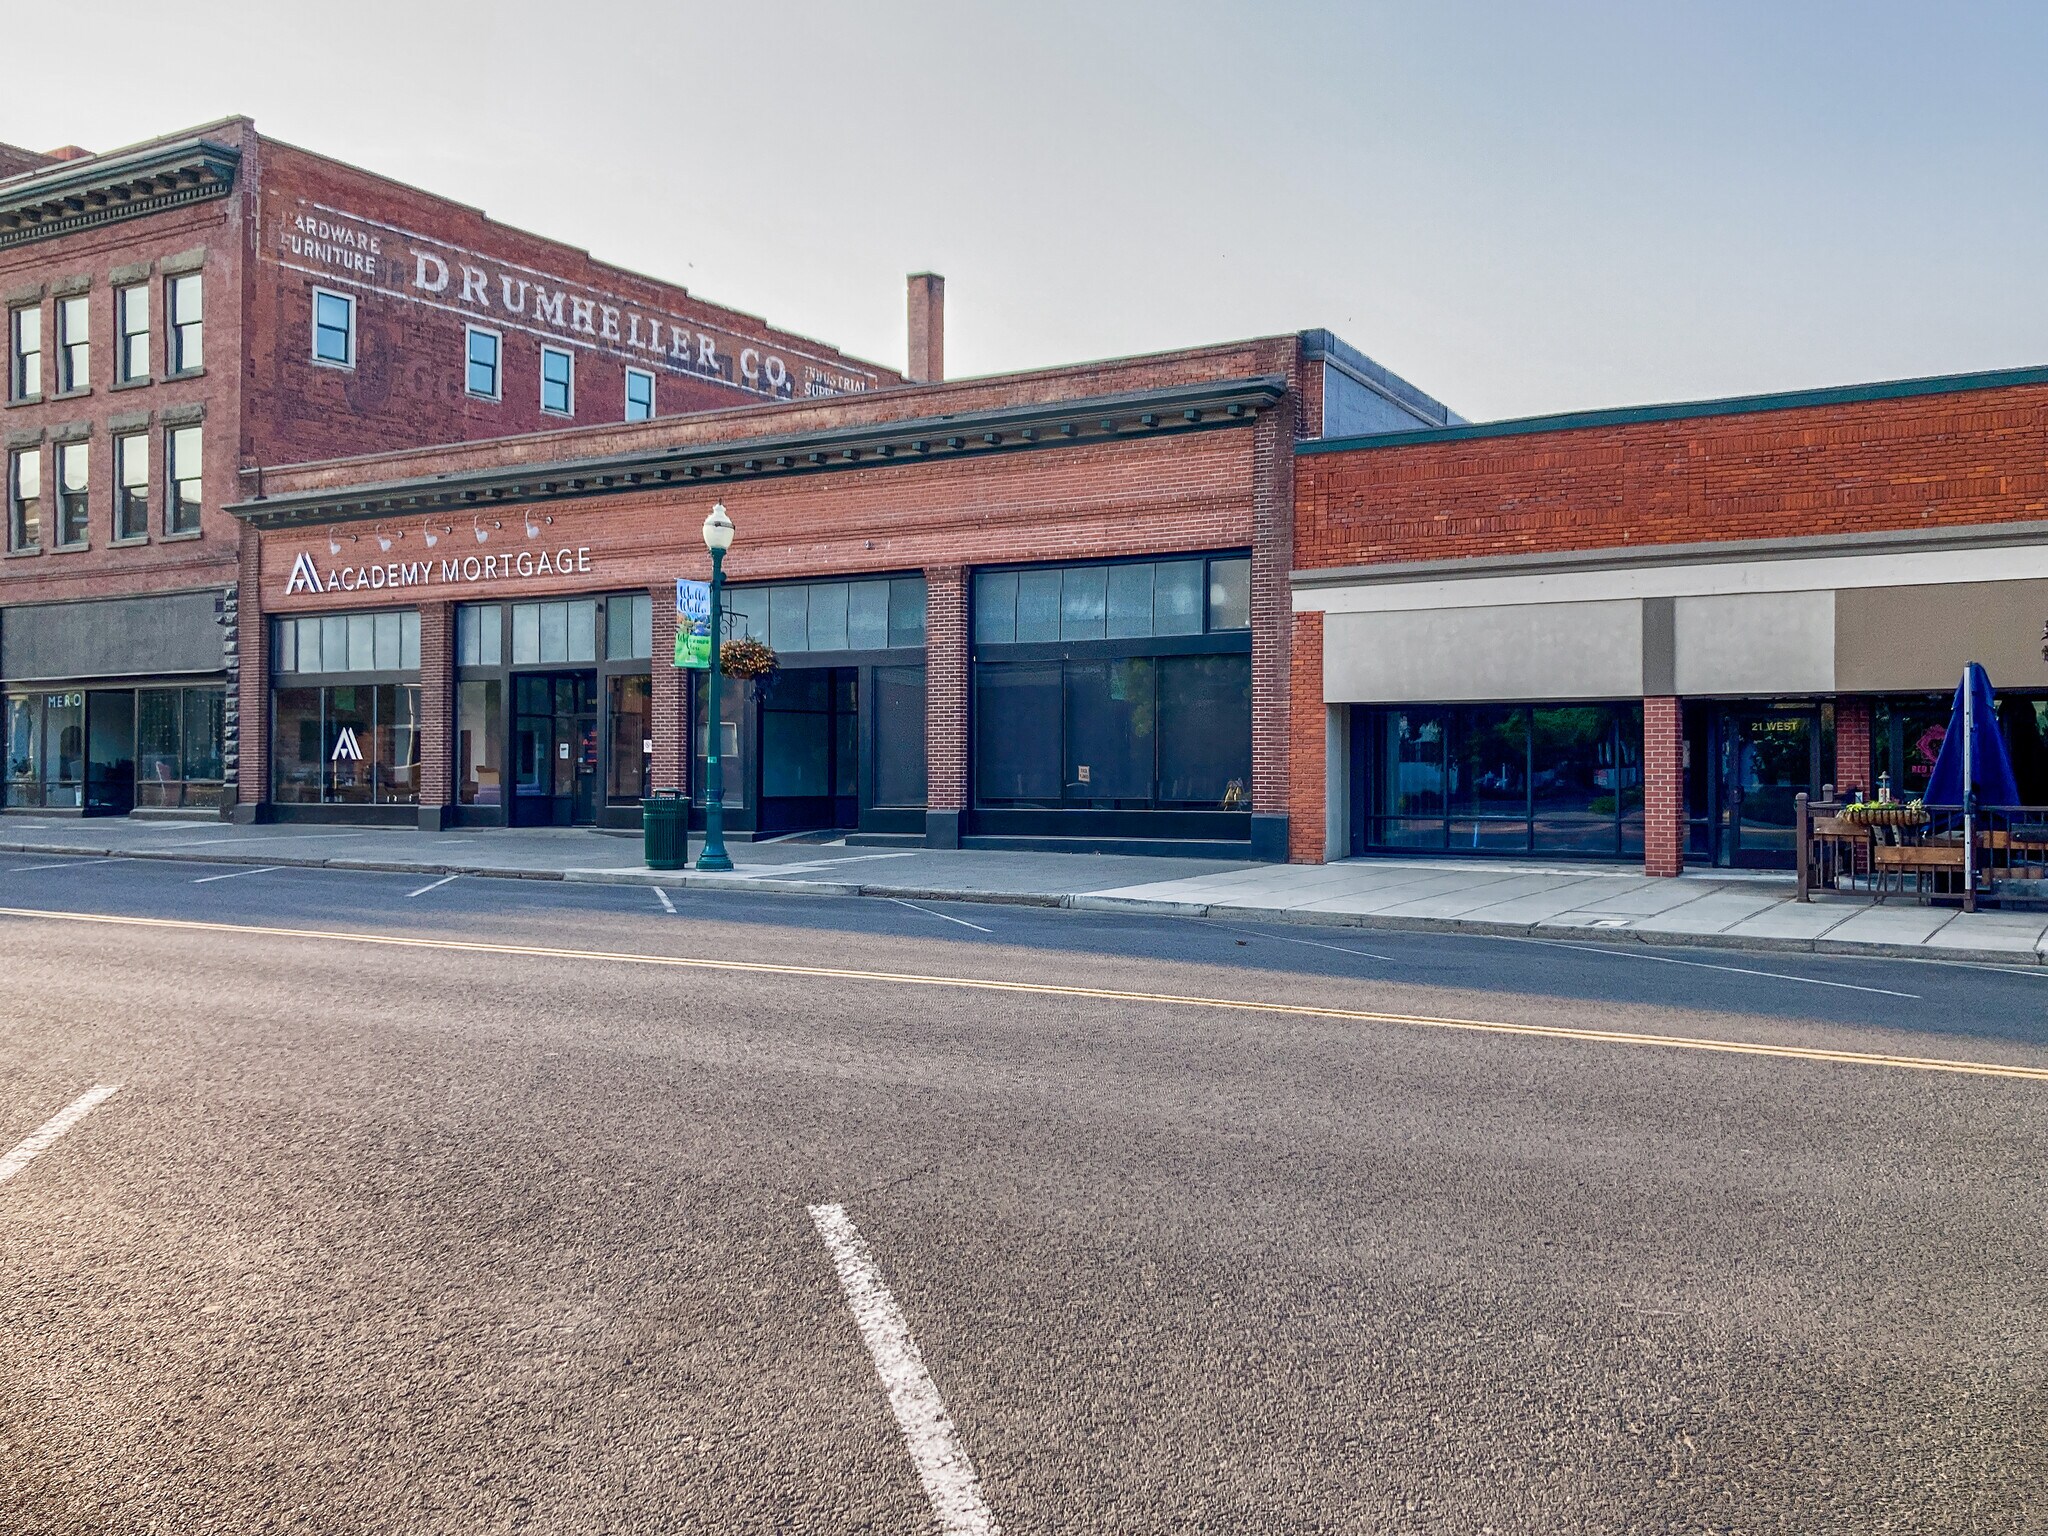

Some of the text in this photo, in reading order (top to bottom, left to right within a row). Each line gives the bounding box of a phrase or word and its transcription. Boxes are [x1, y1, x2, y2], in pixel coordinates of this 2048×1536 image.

[410, 248, 721, 371] DRUMHELLER
[327, 560, 434, 591] ACADEMY
[442, 547, 592, 583] MORTGAGE
[48, 693, 82, 709] MERO
[1751, 721, 1798, 731] 21 WEST
